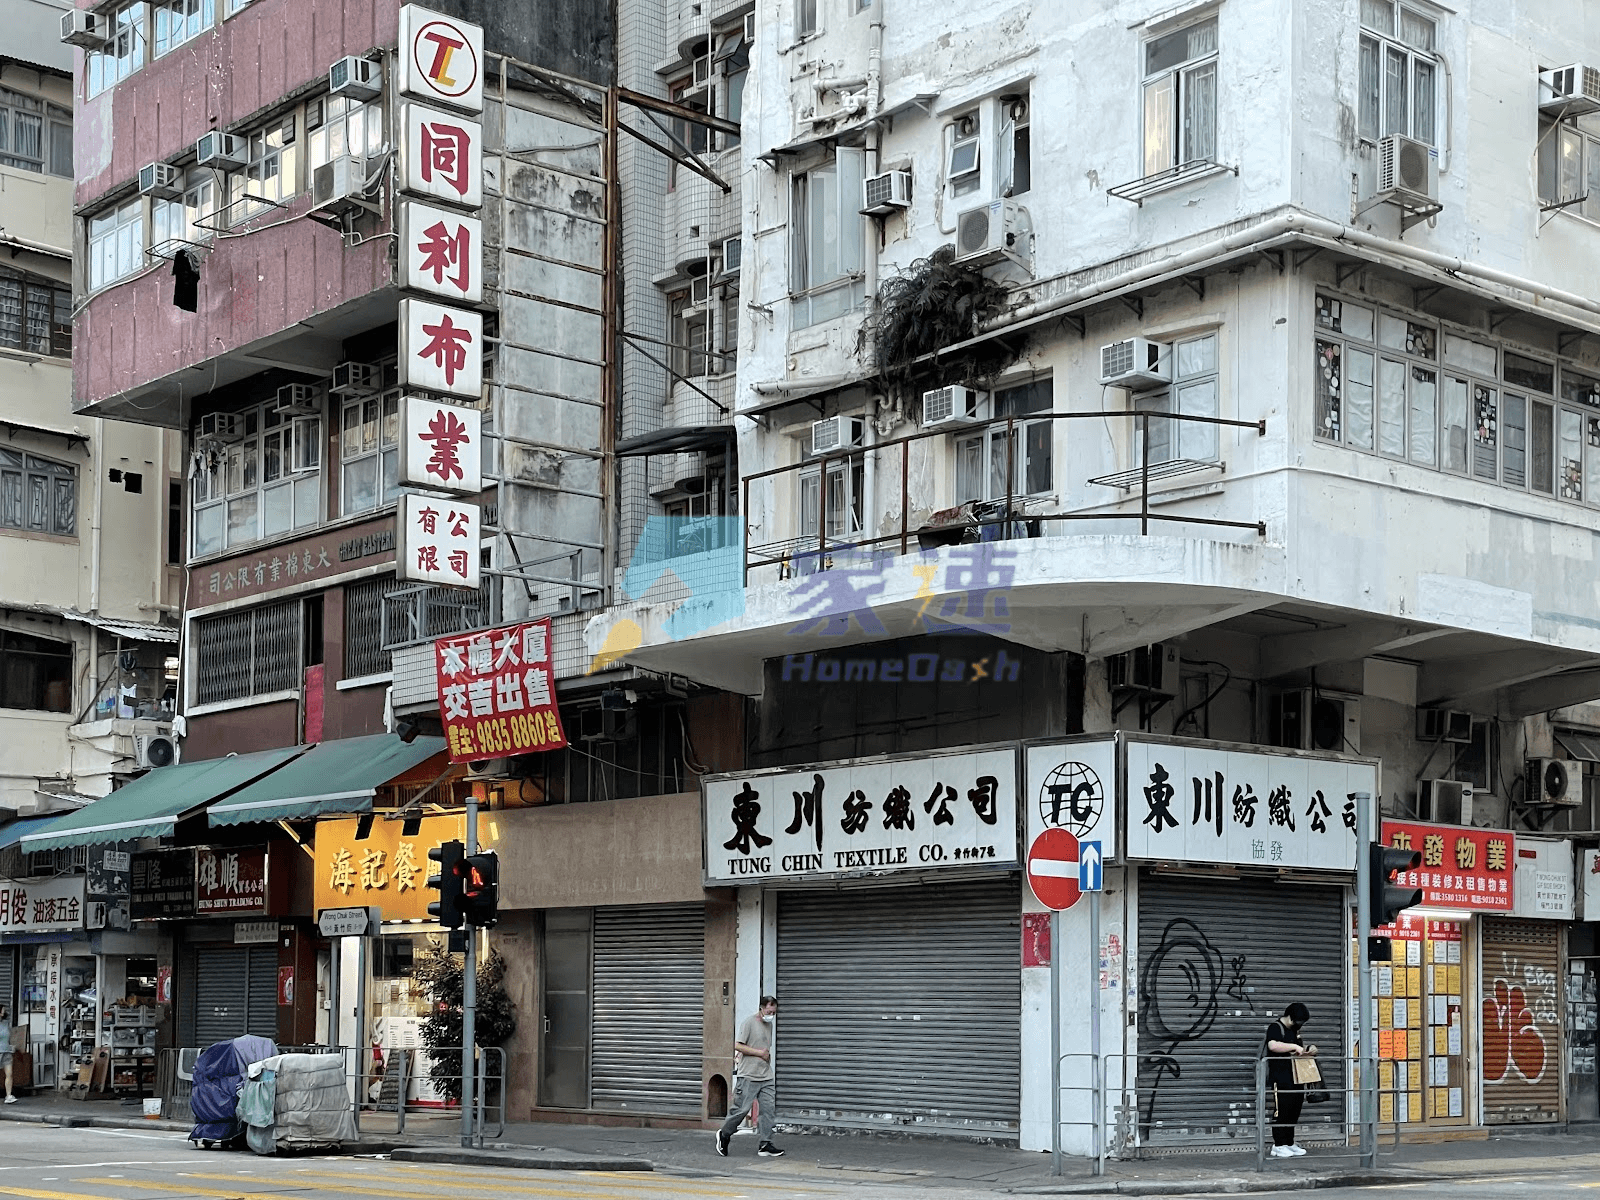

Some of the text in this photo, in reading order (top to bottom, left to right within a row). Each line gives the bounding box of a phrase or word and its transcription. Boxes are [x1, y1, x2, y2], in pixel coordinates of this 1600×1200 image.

[442, 668, 551, 721] 交吉出售
[477, 718, 511, 753] 9835
[510, 712, 546, 748] 8860
[723, 773, 999, 855] 東川紡織公司
[1048, 781, 1095, 825] TC
[728, 844, 947, 875] TUNG CHIN TEXTILE CO.
[1251, 839, 1283, 862] 協發
[33, 896, 79, 924] 油漆五金
[229, 897, 254, 907] TRADING
